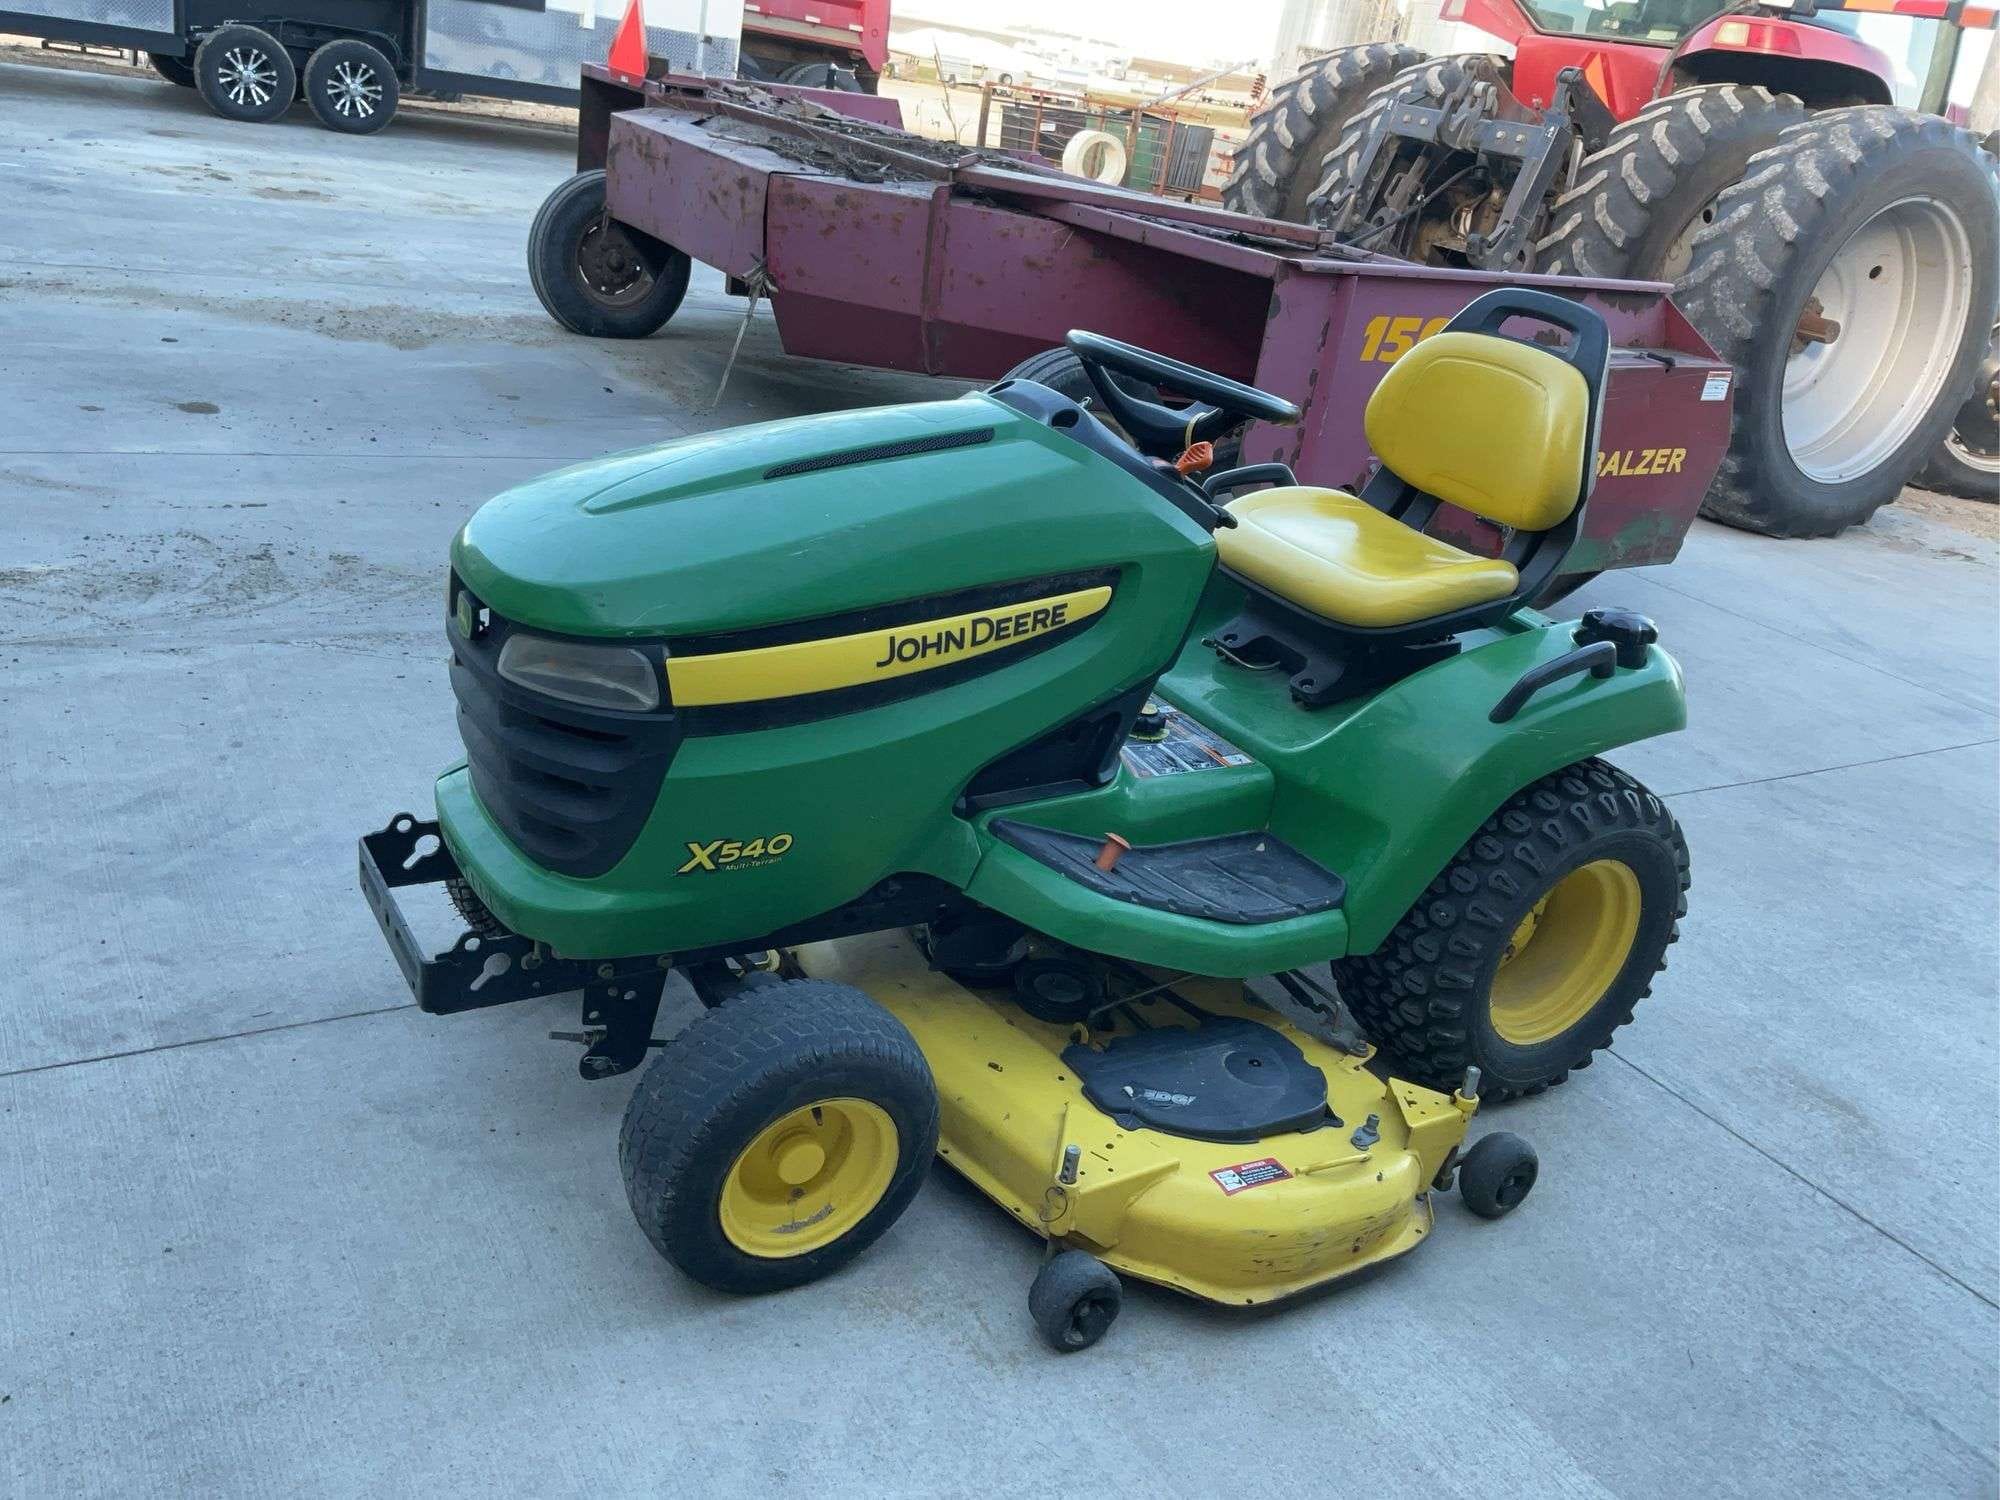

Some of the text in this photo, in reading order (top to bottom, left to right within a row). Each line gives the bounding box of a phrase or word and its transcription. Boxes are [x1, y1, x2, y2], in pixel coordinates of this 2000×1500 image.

[876, 603, 1068, 668] JOHN DEERE
[675, 834, 793, 874] X540
